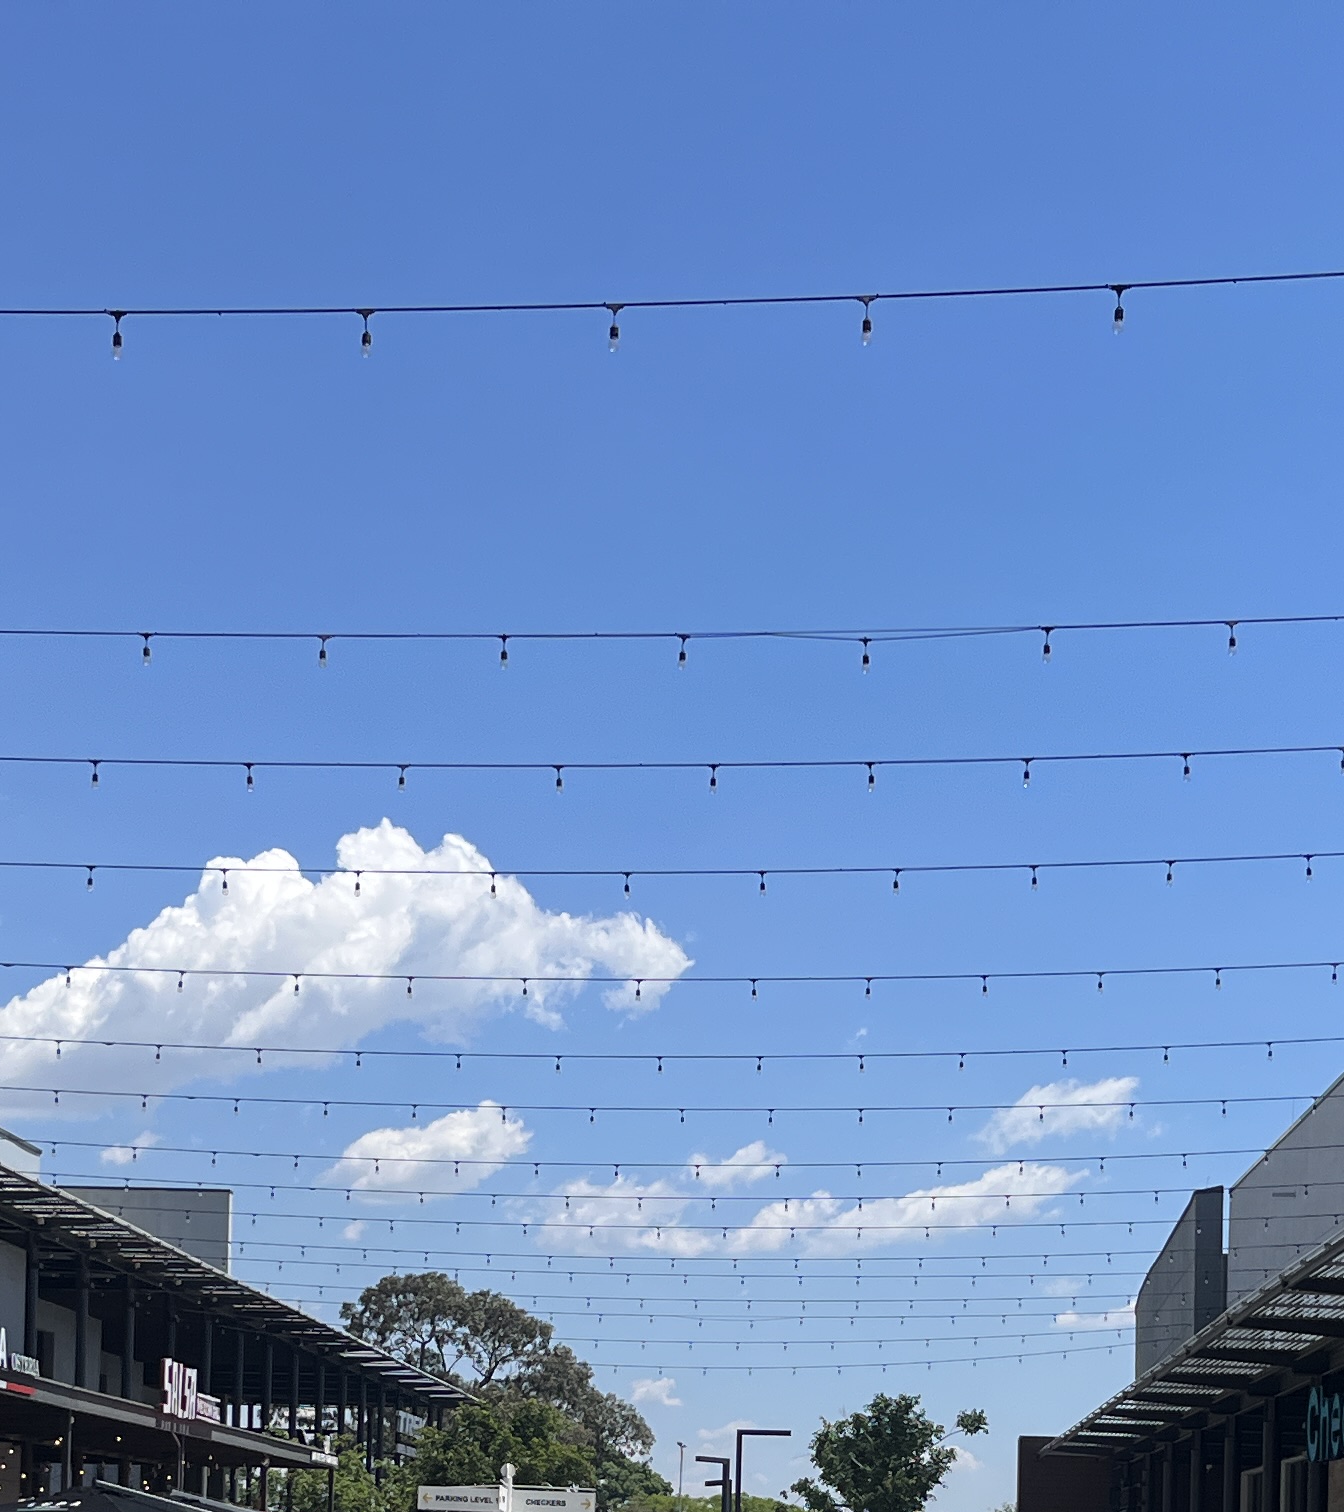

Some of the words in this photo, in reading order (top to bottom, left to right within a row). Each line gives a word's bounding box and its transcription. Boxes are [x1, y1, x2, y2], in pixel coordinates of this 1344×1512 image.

[162, 1357, 198, 1420] SALSA
[436, 1494, 468, 1504] PARKING
[470, 1496, 493, 1504] LEVEL
[525, 1498, 567, 1507] CHECKERS
